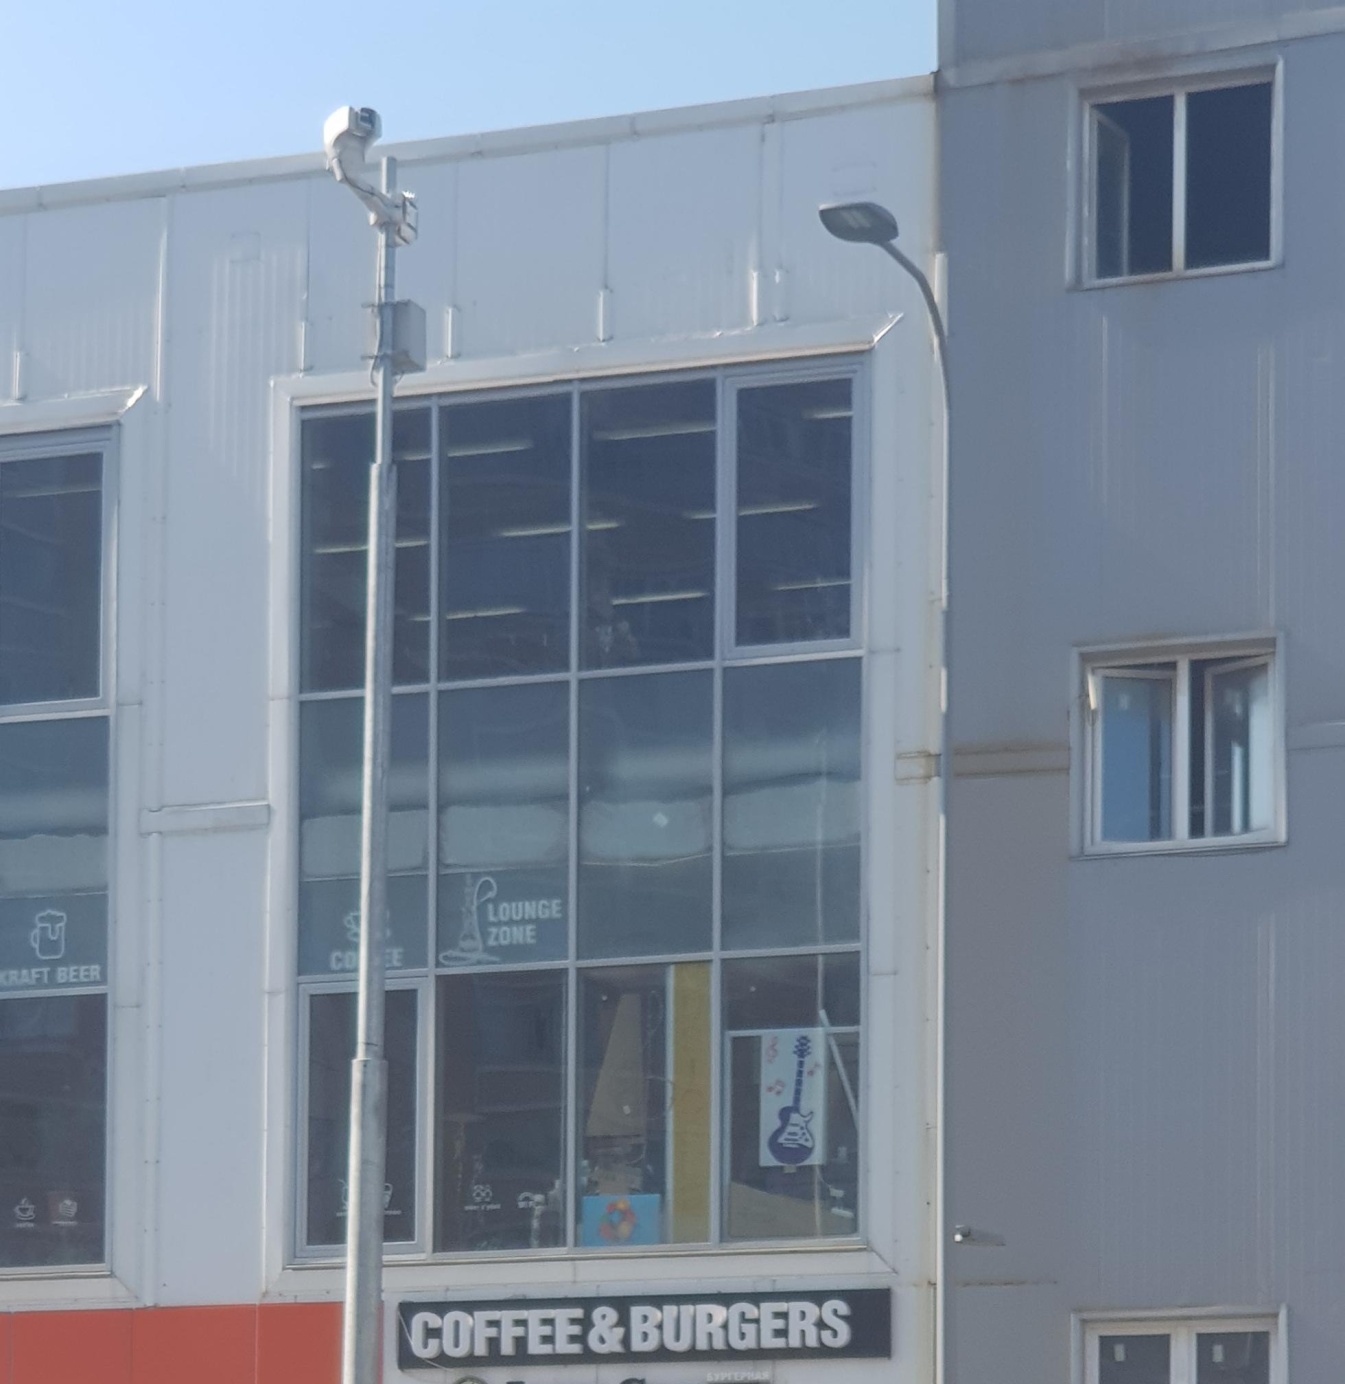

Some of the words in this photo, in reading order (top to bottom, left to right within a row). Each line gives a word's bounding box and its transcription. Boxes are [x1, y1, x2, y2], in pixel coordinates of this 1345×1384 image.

[487, 899, 562, 922] LOUNGE
[487, 924, 537, 946] ZONE
[330, 948, 404, 971] COEE
[56, 965, 101, 983] BEER
